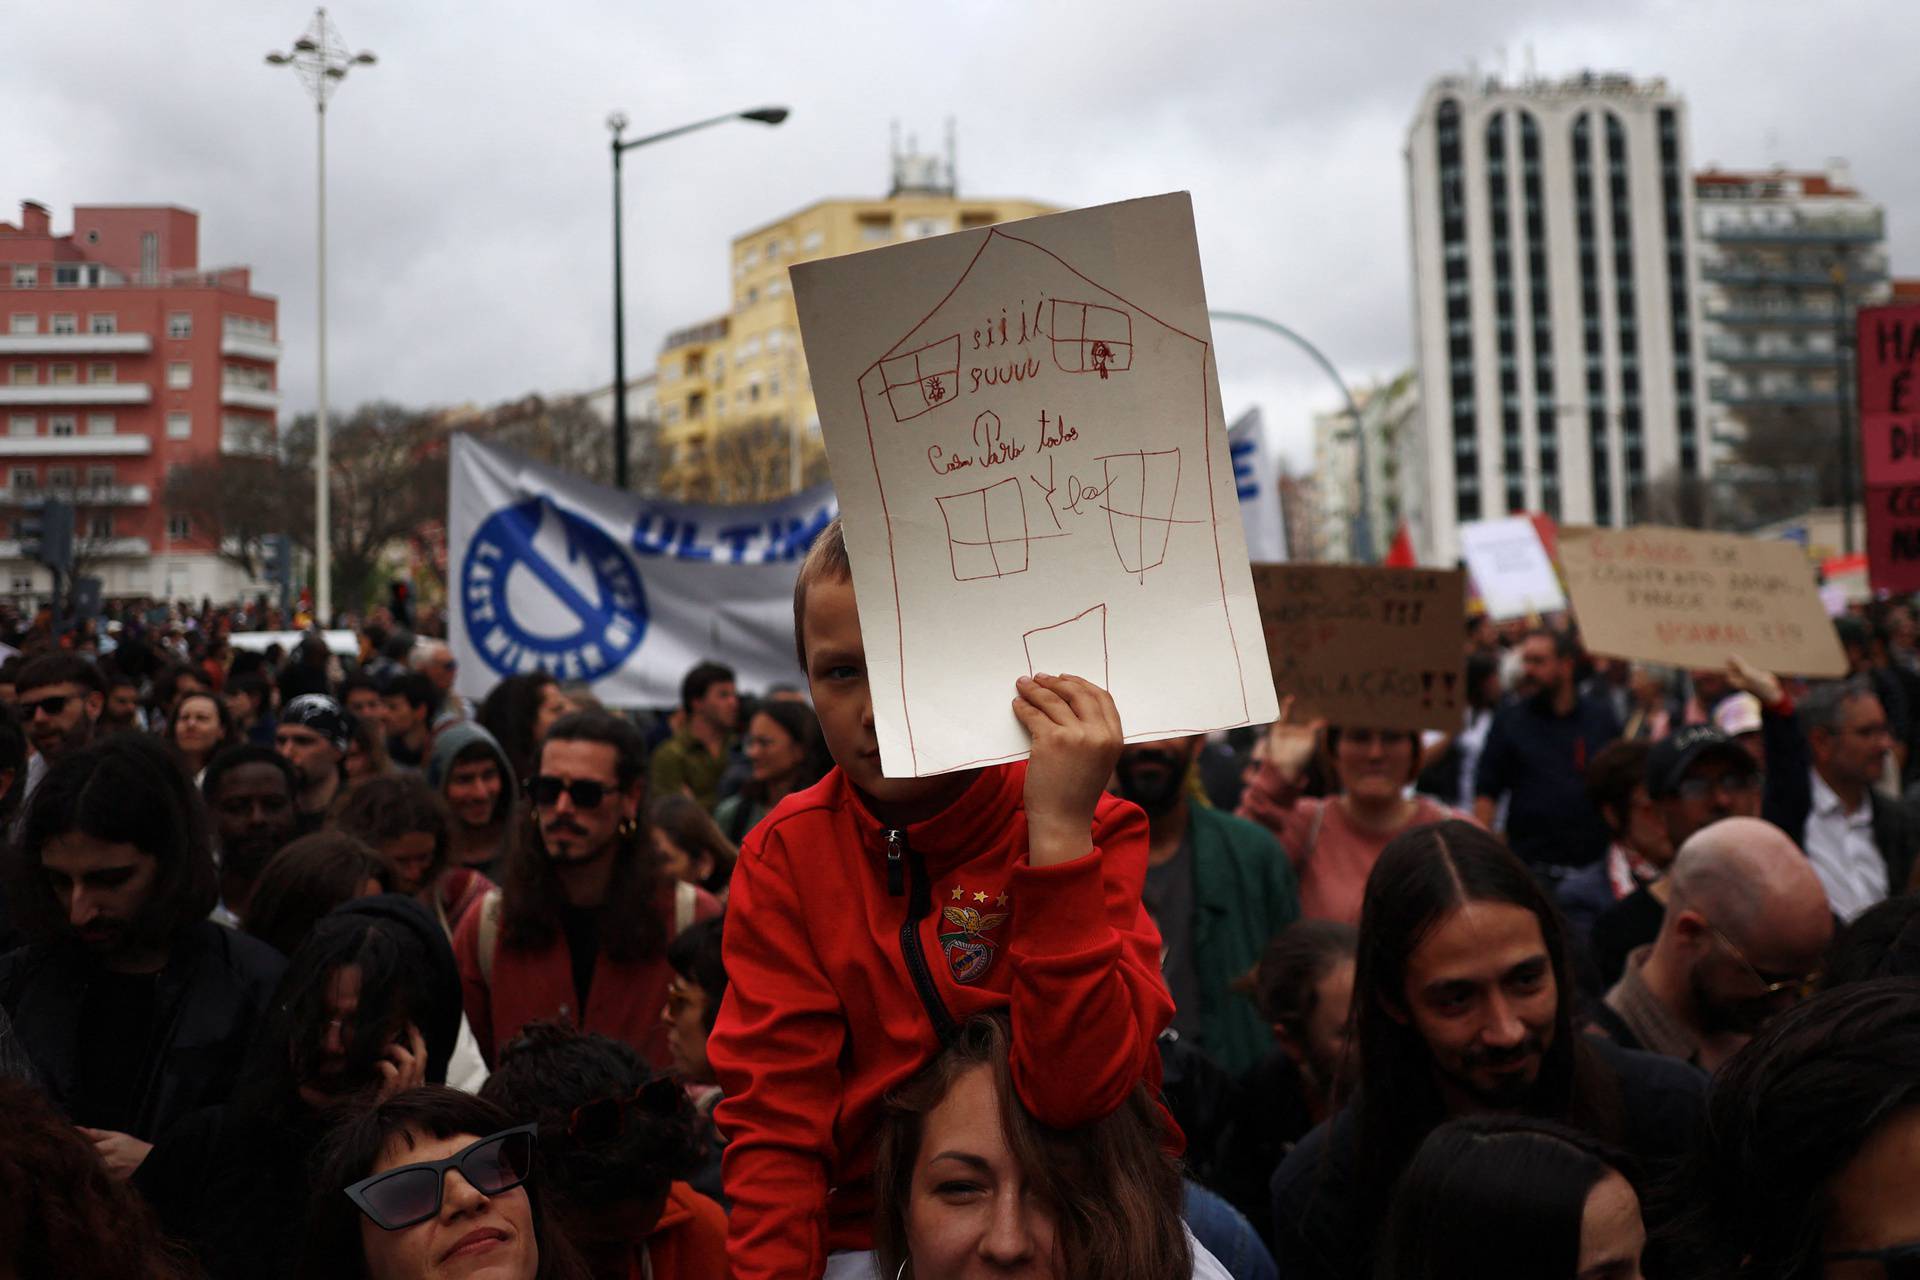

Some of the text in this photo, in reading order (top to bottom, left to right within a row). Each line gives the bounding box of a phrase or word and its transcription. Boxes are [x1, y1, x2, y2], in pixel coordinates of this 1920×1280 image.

[1037, 409, 1079, 453] todos
[467, 540, 503, 623] LAST
[484, 623, 605, 679] WINTER
